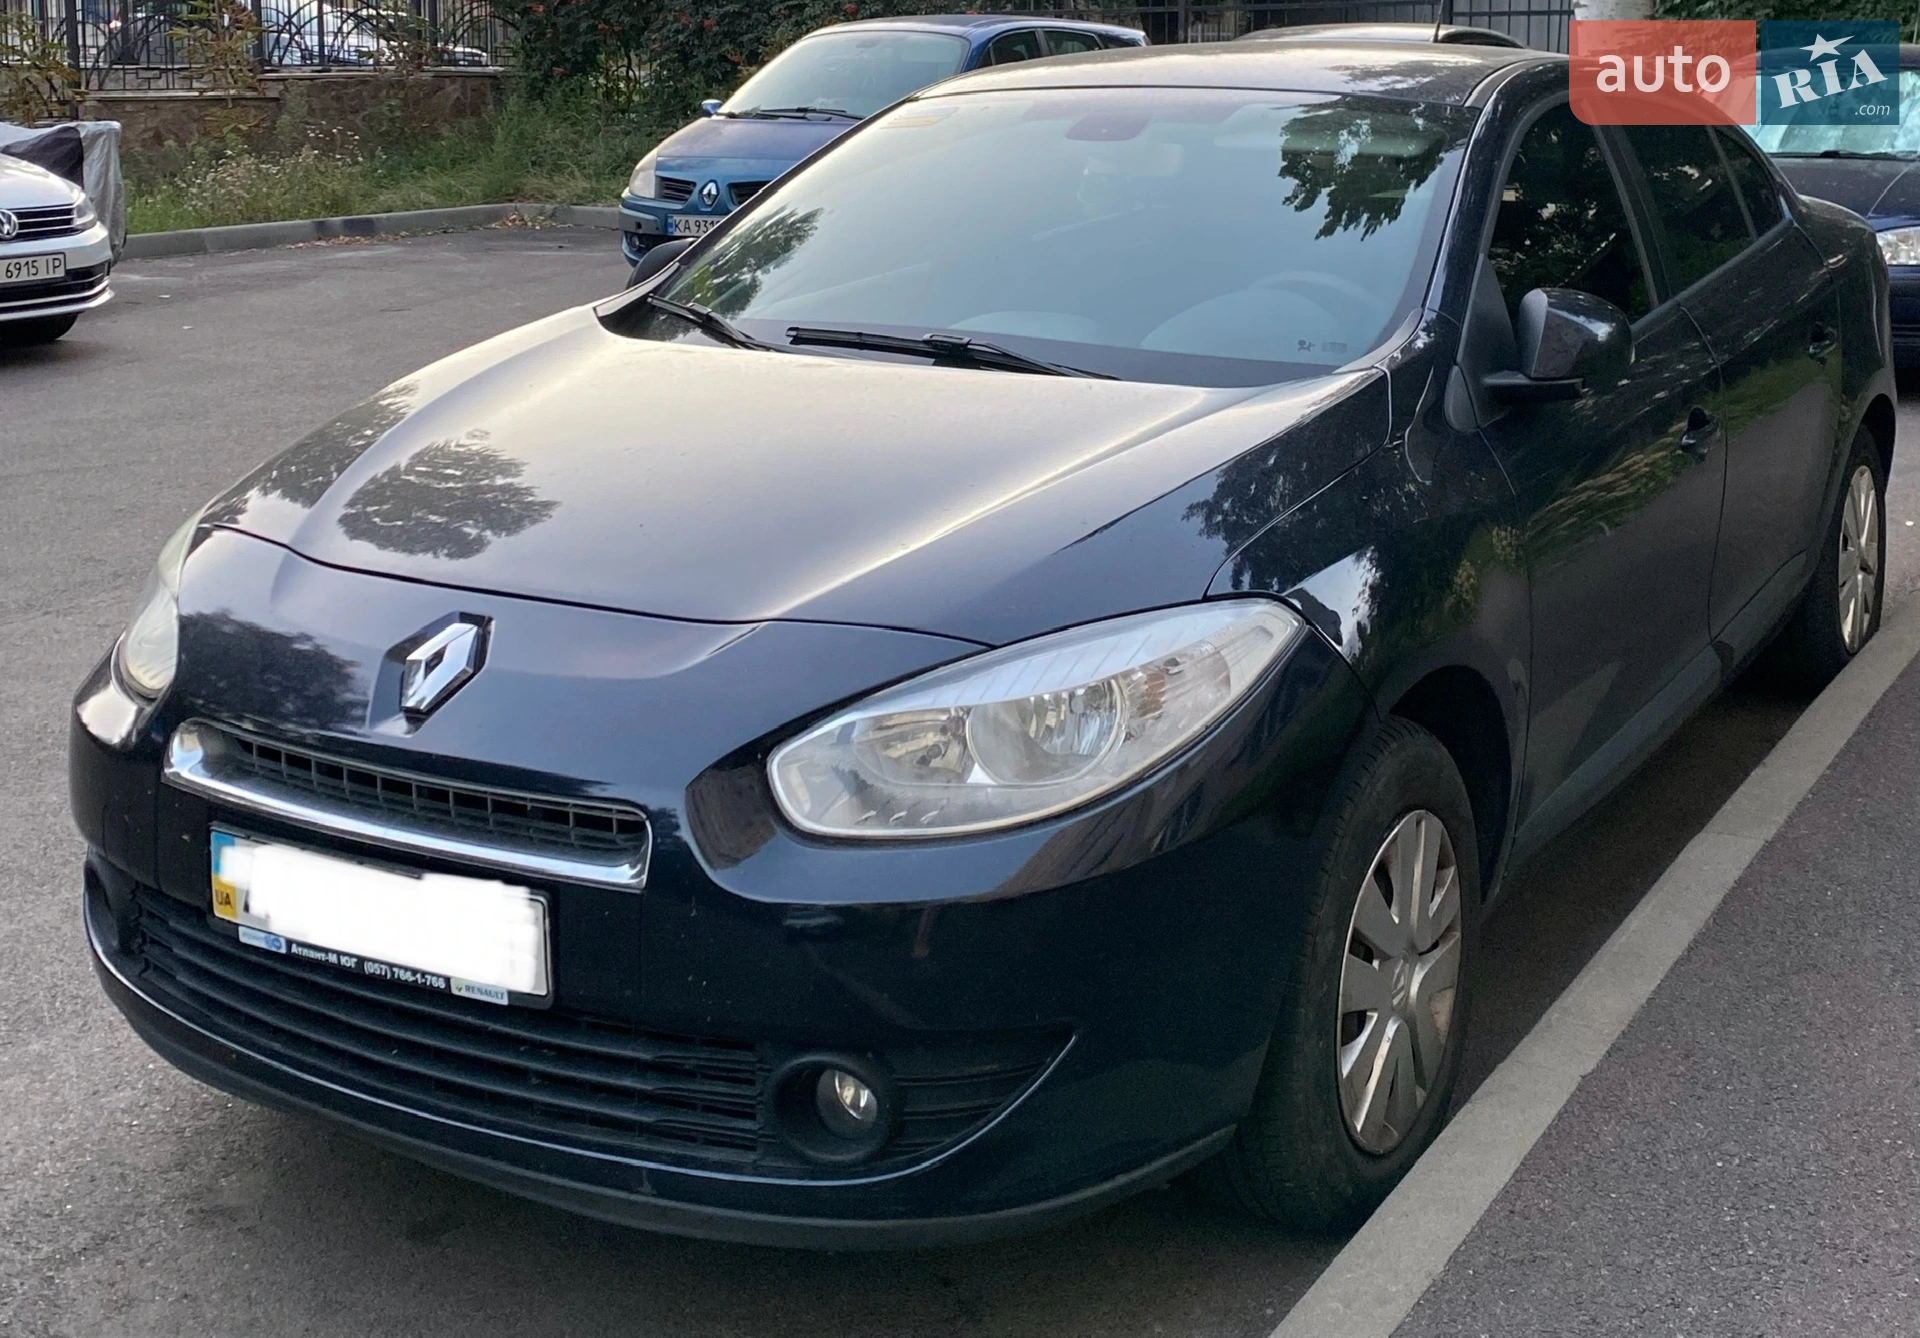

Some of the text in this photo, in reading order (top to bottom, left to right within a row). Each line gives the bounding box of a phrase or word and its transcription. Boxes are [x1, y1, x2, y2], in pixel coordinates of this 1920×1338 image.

[674, 219, 721, 234] KA 931
[5, 257, 62, 279] 6915 IP
[215, 889, 233, 909] UA
[363, 960, 391, 980] (057)
[392, 967, 446, 989] 766-1-766
[464, 984, 505, 1000] RENAULT
